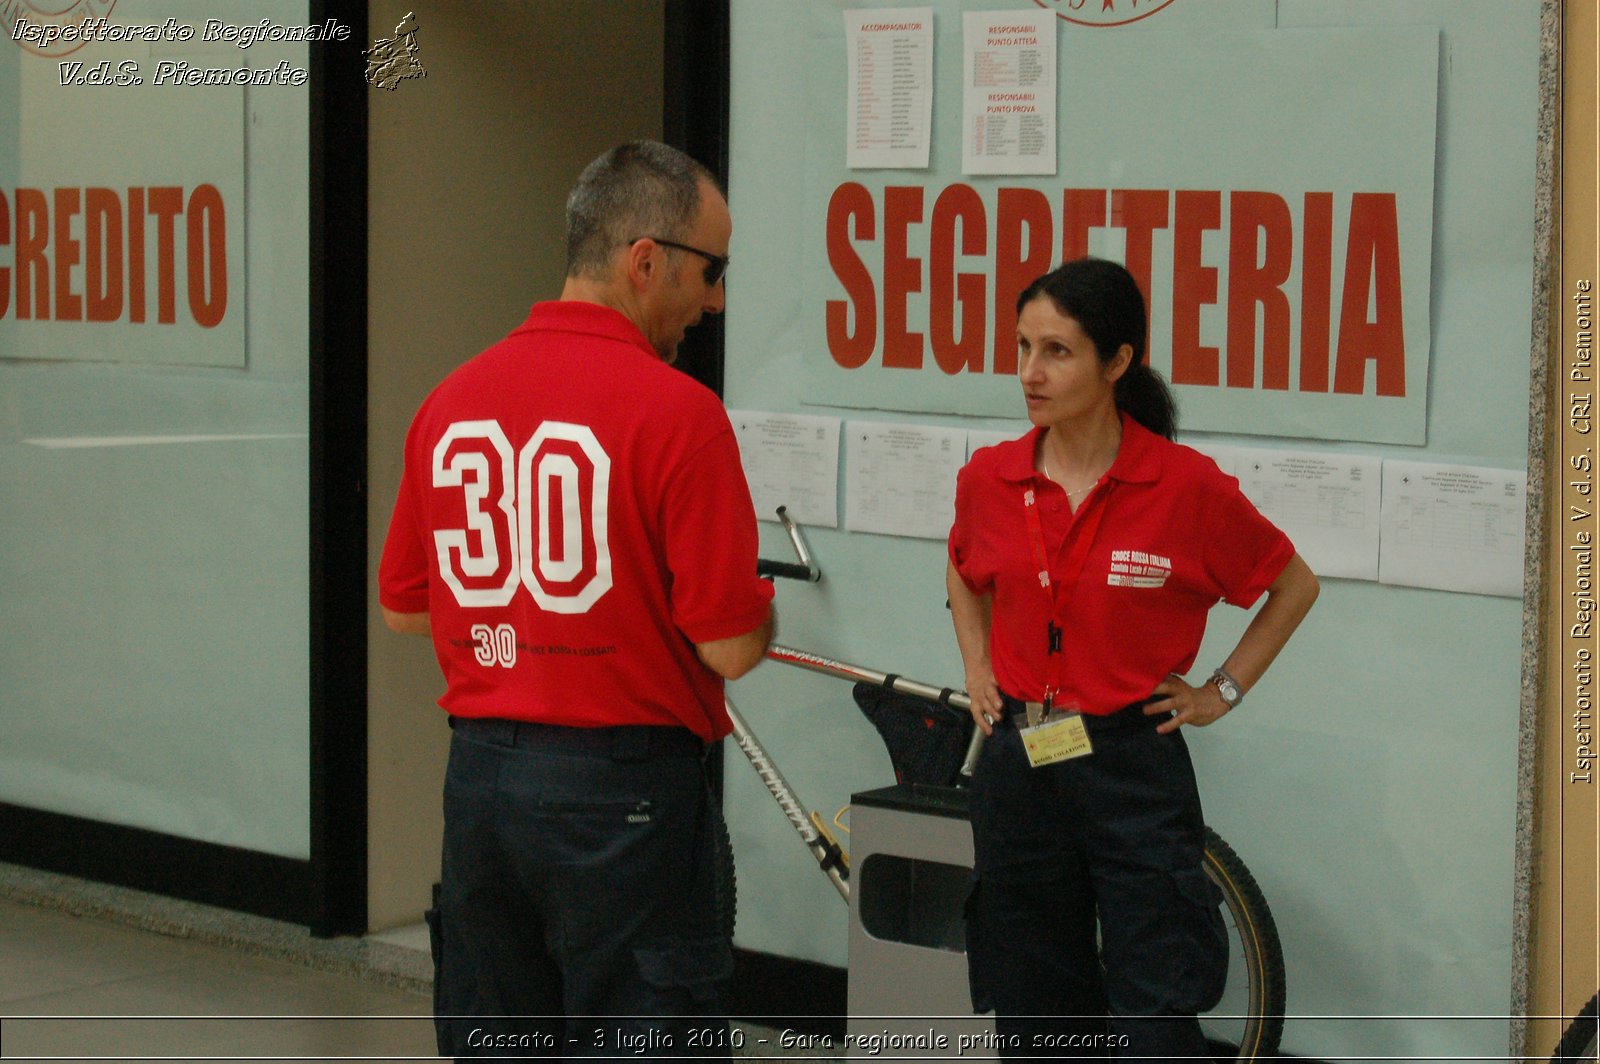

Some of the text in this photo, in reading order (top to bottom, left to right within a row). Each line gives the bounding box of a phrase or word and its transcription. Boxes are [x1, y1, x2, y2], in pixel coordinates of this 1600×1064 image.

[861, 23, 922, 33] ACCOMPAGNATORI
[988, 26, 1036, 34] RESPONSABILI
[987, 37, 1037, 47] PUNTO ATTESA
[988, 93, 1036, 102] RESPONSABILI
[987, 105, 1036, 114] PUNTO PROVA
[0, 183, 228, 329] REDITO
[432, 419, 613, 614] 30
[1112, 551, 1172, 570] CROCE ROSSA ITALIANA
[471, 623, 517, 669] 30
